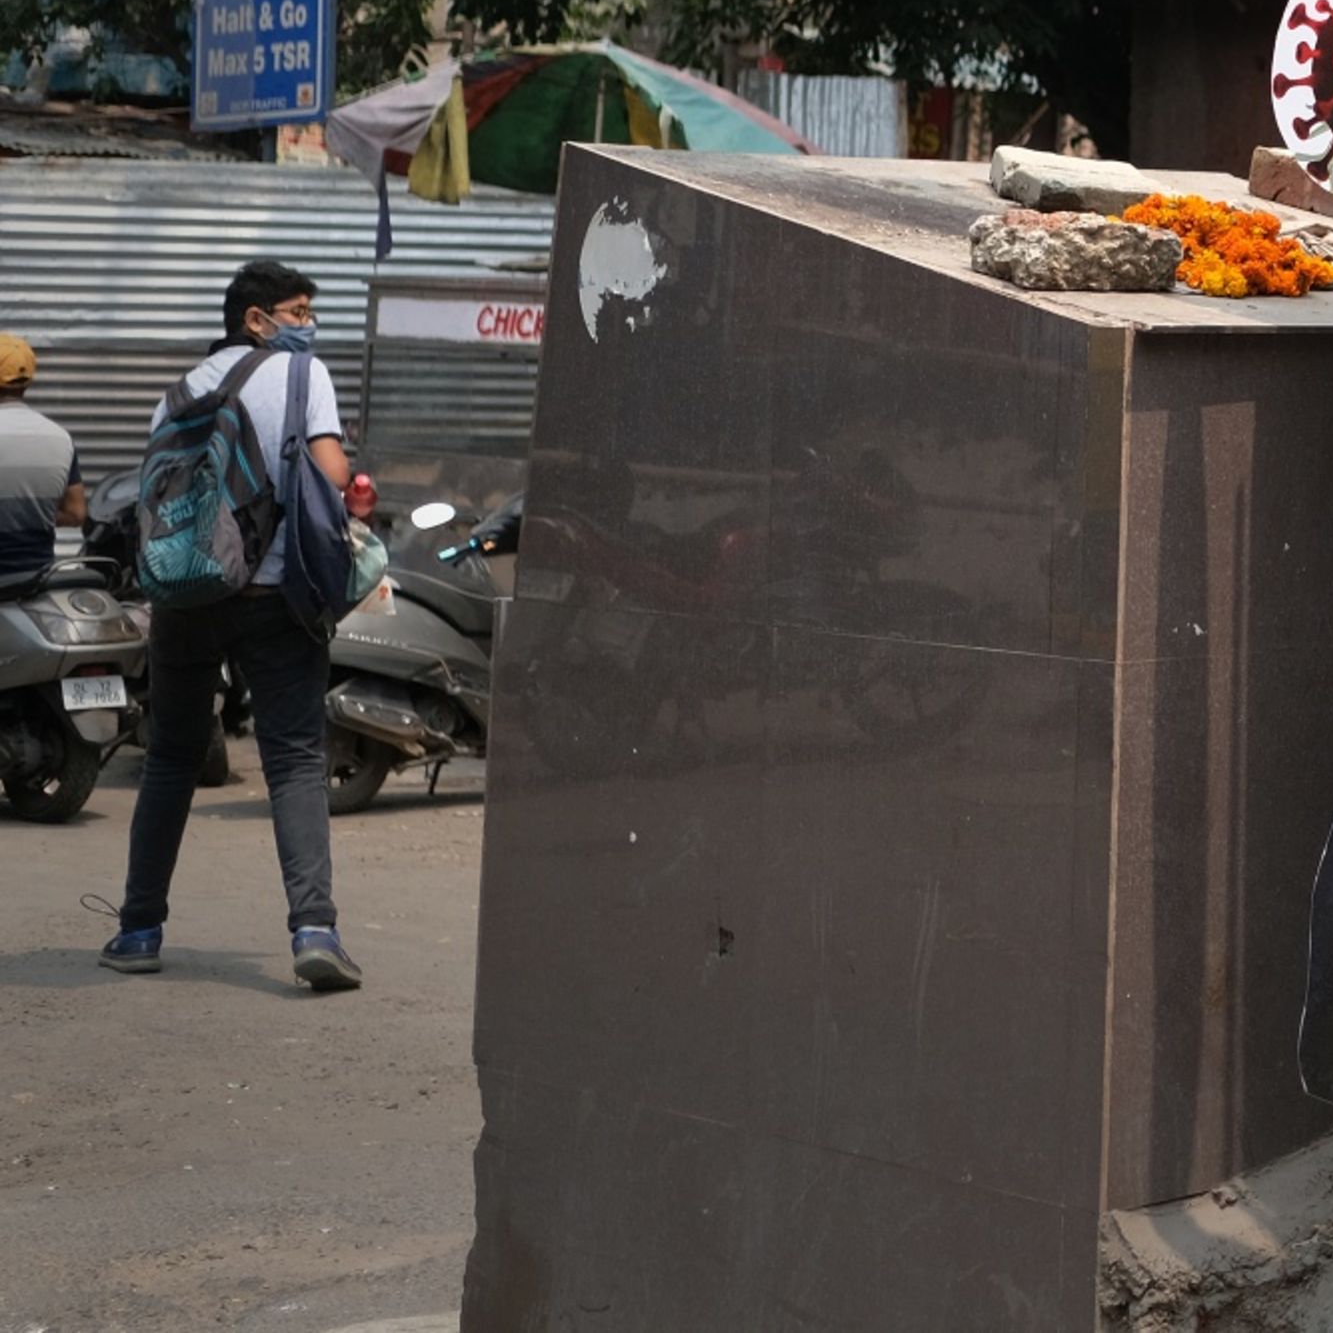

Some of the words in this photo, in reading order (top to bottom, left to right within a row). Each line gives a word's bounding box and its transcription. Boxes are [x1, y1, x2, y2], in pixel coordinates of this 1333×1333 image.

[212, 5, 252, 36] Halt
[259, 1, 274, 31] &
[208, 47, 248, 78] Max
[253, 46, 265, 74] 5
[271, 40, 311, 72] TSR
